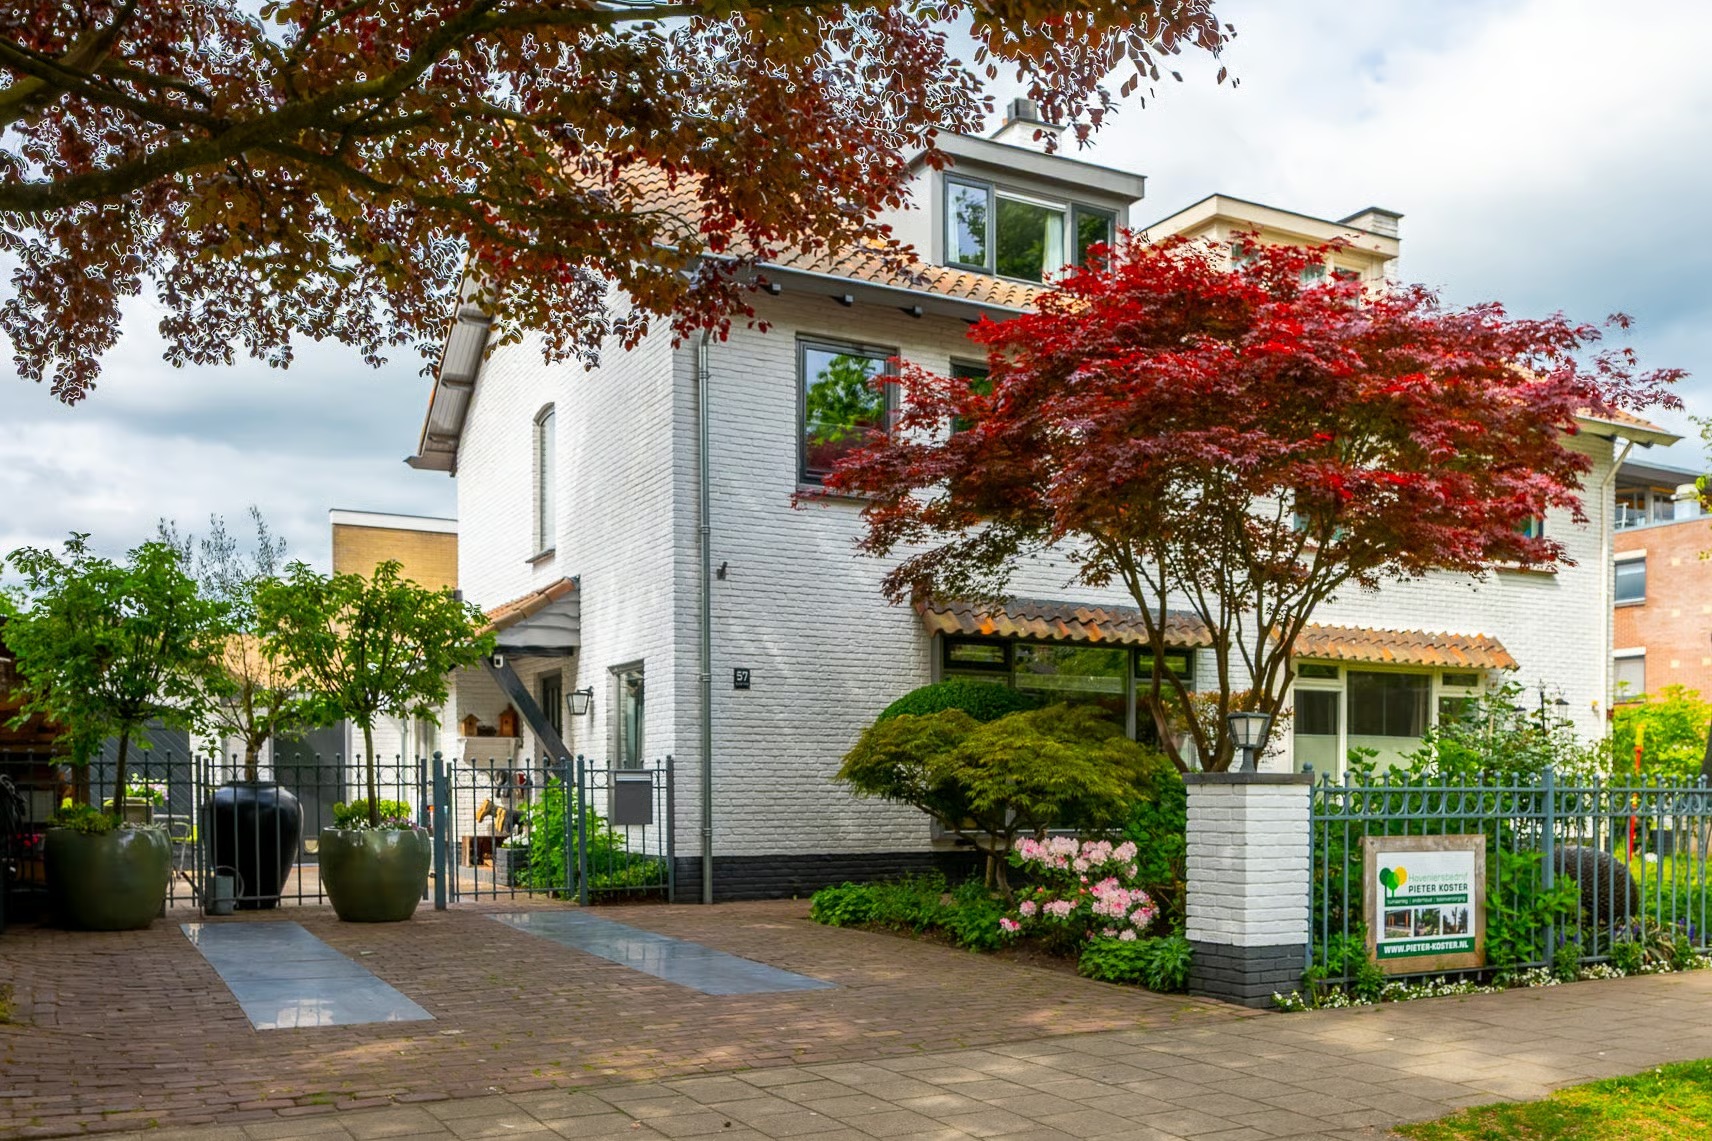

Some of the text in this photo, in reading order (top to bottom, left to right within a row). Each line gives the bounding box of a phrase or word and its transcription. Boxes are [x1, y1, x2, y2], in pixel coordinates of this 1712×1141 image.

[736, 670, 748, 681] 57
[1408, 883, 1468, 893] PIETER KOSTER
[1384, 940, 1469, 954] WWW.PIETER-KOSTER.NL
